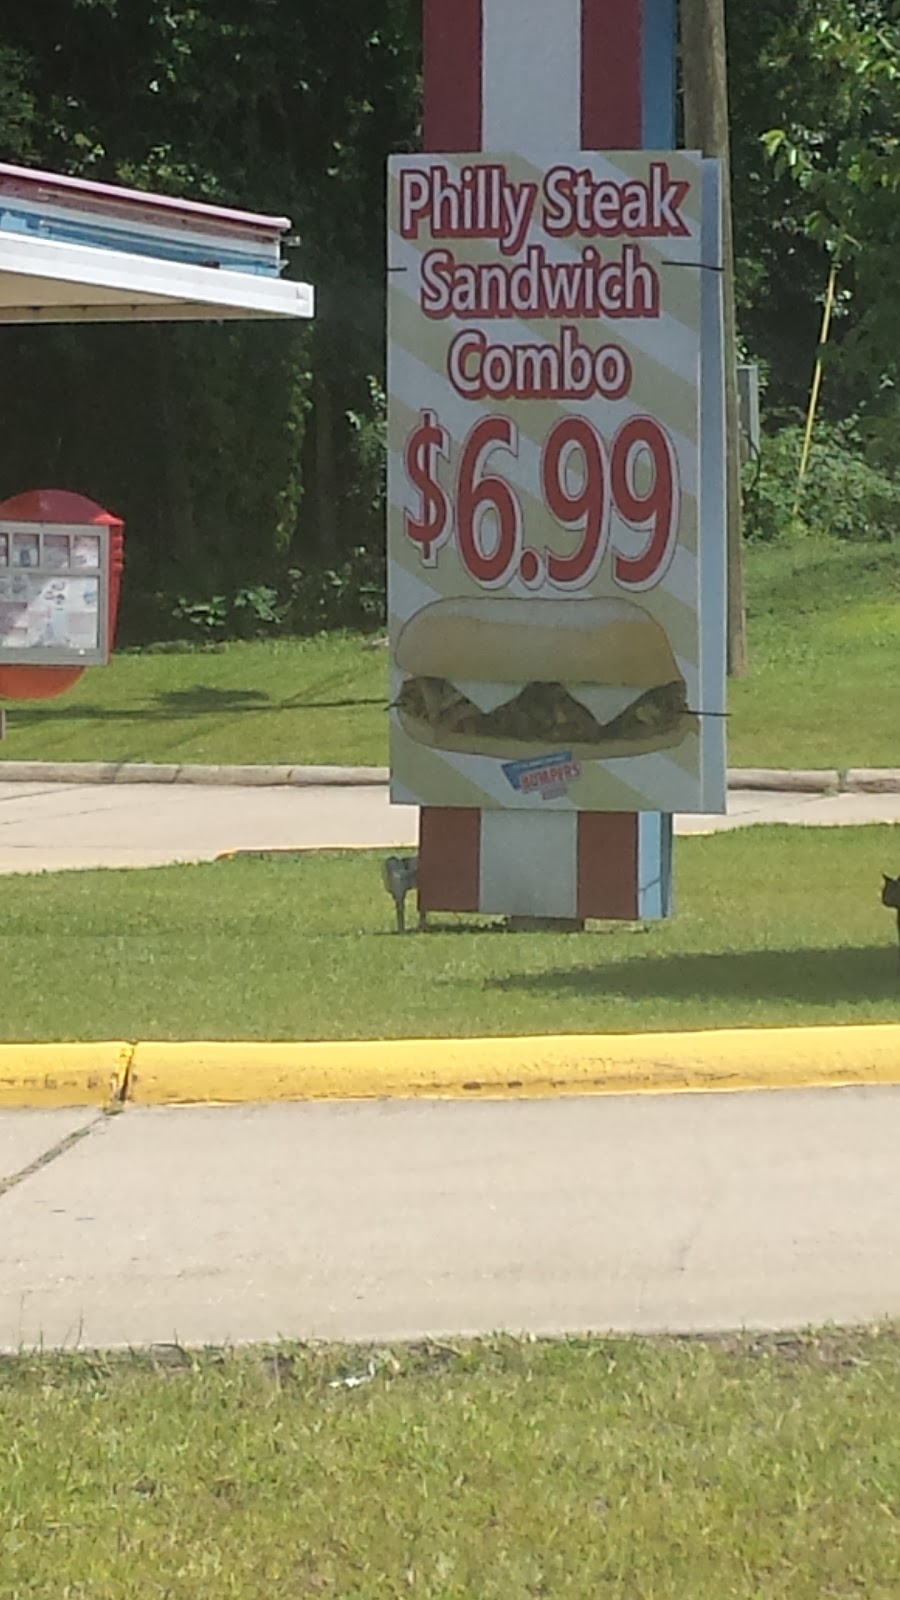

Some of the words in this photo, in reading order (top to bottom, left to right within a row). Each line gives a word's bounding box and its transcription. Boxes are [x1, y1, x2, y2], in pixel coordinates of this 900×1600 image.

[400, 165, 538, 256] Philly
[543, 162, 692, 238] Steak
[420, 244, 660, 319] Sandwich
[447, 325, 632, 400] Combo
[403, 408, 681, 593] $6.99
